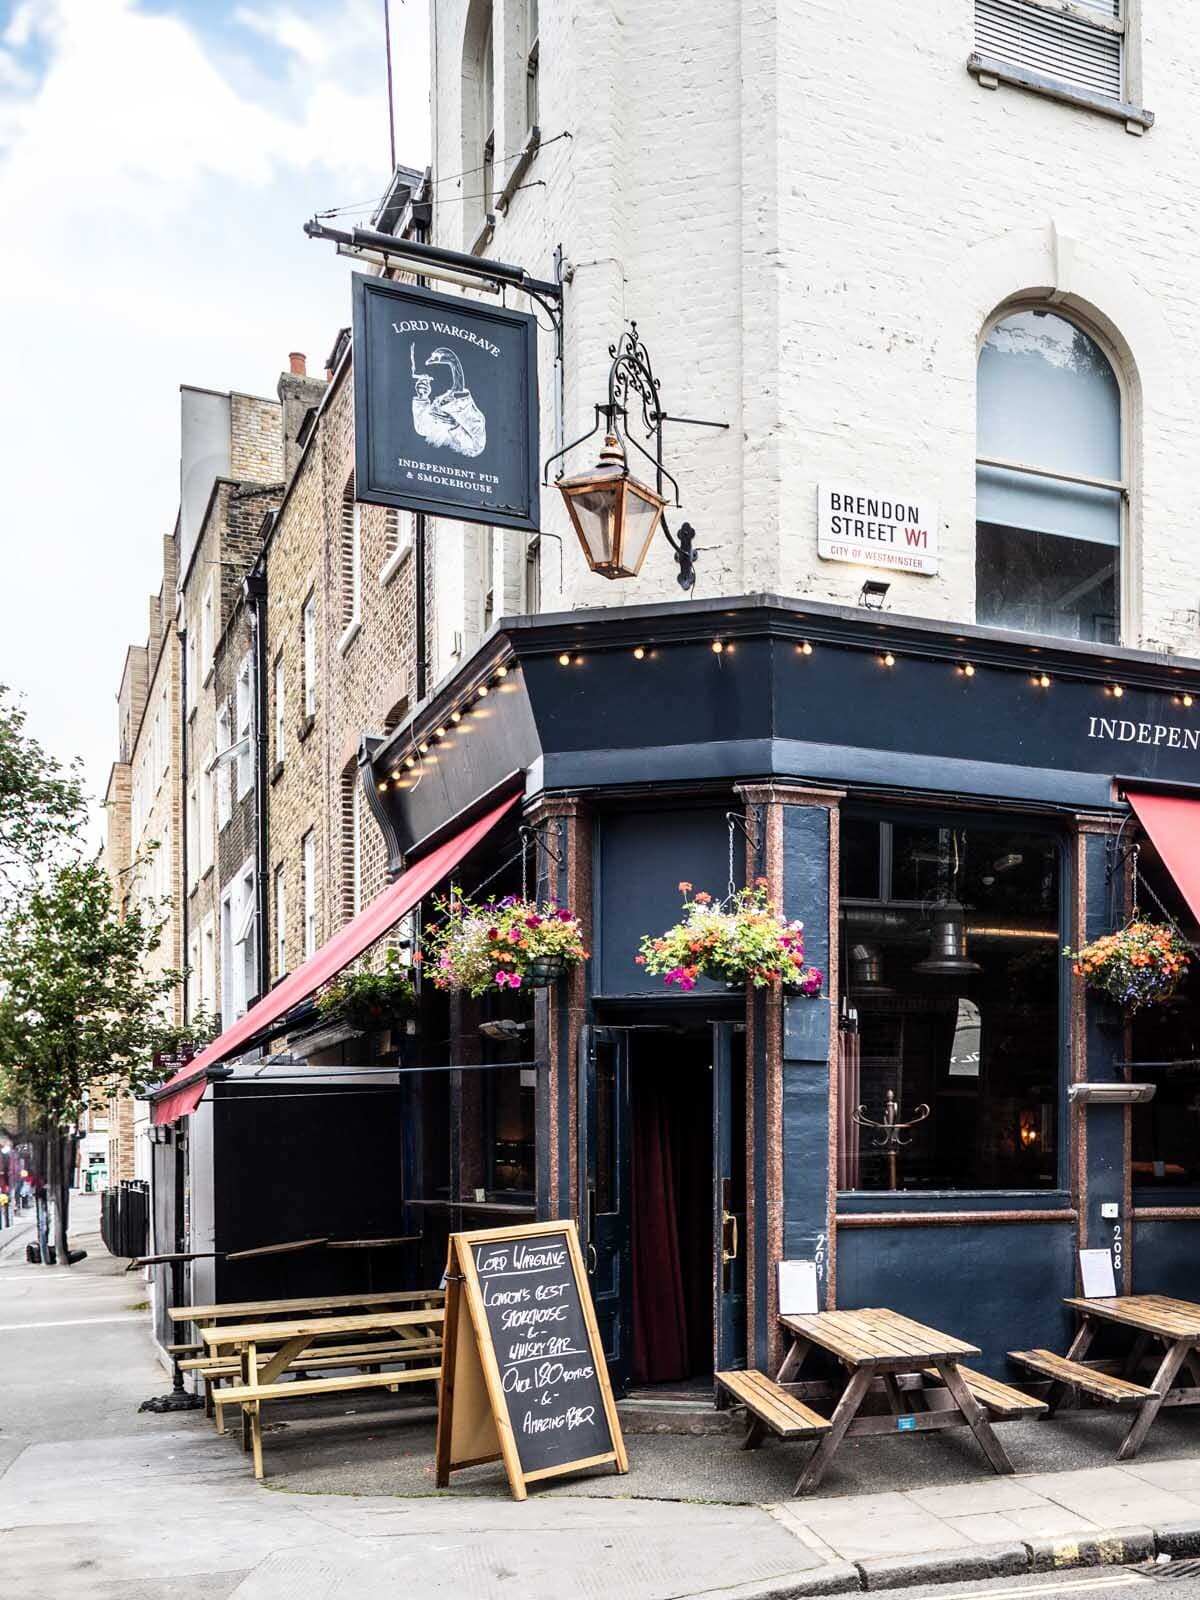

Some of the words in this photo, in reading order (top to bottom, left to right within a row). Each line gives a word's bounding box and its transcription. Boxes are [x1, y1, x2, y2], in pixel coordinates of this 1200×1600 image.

[391, 320, 429, 334] LORD
[431, 321, 501, 357] WARGRAVE
[398, 458, 476, 480] INDEPENDENT
[479, 473, 499, 484] PUB
[406, 471, 414, 479] &
[417, 472, 493, 494] SMOKEHOUSE
[831, 492, 919, 524] BRENDON
[831, 515, 897, 543] STREET
[904, 527, 928, 549] W1
[830, 545, 849, 556] CITY
[852, 549, 862, 557] OF
[865, 551, 923, 568] WESTMINSTER
[477, 1248, 507, 1272] LORD
[513, 1245, 567, 1269] WARGRAVE
[815, 1234, 825, 1281] 209
[1113, 1225, 1122, 1270] 208
[535, 1283, 570, 1300] BEST
[501, 1305, 569, 1330] SMOKEHOUSE
[509, 1342, 546, 1360] WHISKY
[546, 1337, 577, 1353] BAR
[535, 1362, 563, 1388] 180
[563, 1367, 594, 1382] BOTTLES
[565, 1406, 595, 1430] BBQ
